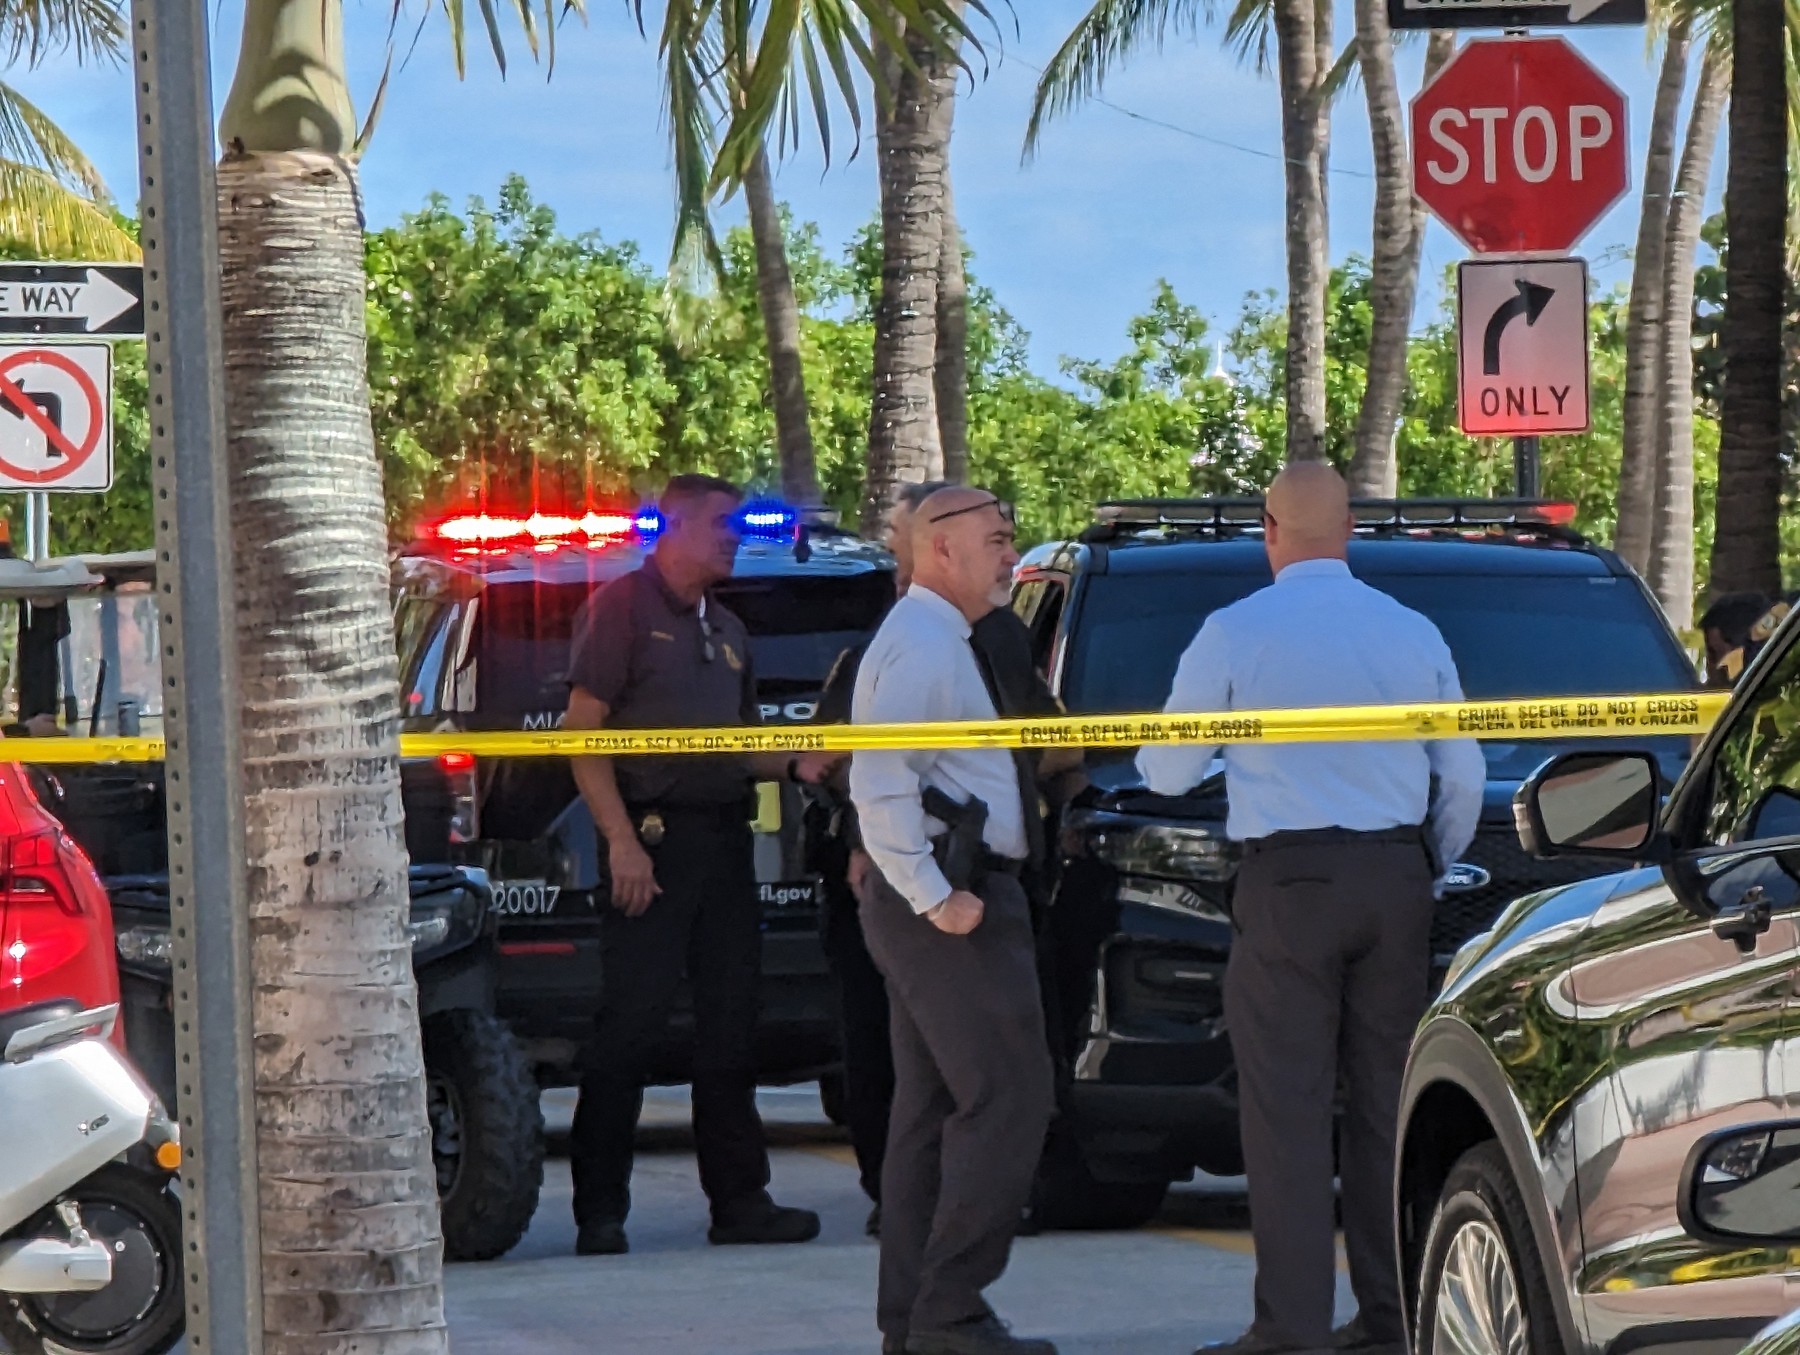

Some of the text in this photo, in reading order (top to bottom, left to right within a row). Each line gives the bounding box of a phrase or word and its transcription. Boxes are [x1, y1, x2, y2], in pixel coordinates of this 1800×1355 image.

[1427, 105, 1612, 184] STOP
[22, 287, 80, 312] WAY
[1481, 385, 1570, 416] ONLY
[1458, 699, 1698, 721] CRIME SCENE DO NOT CROSS
